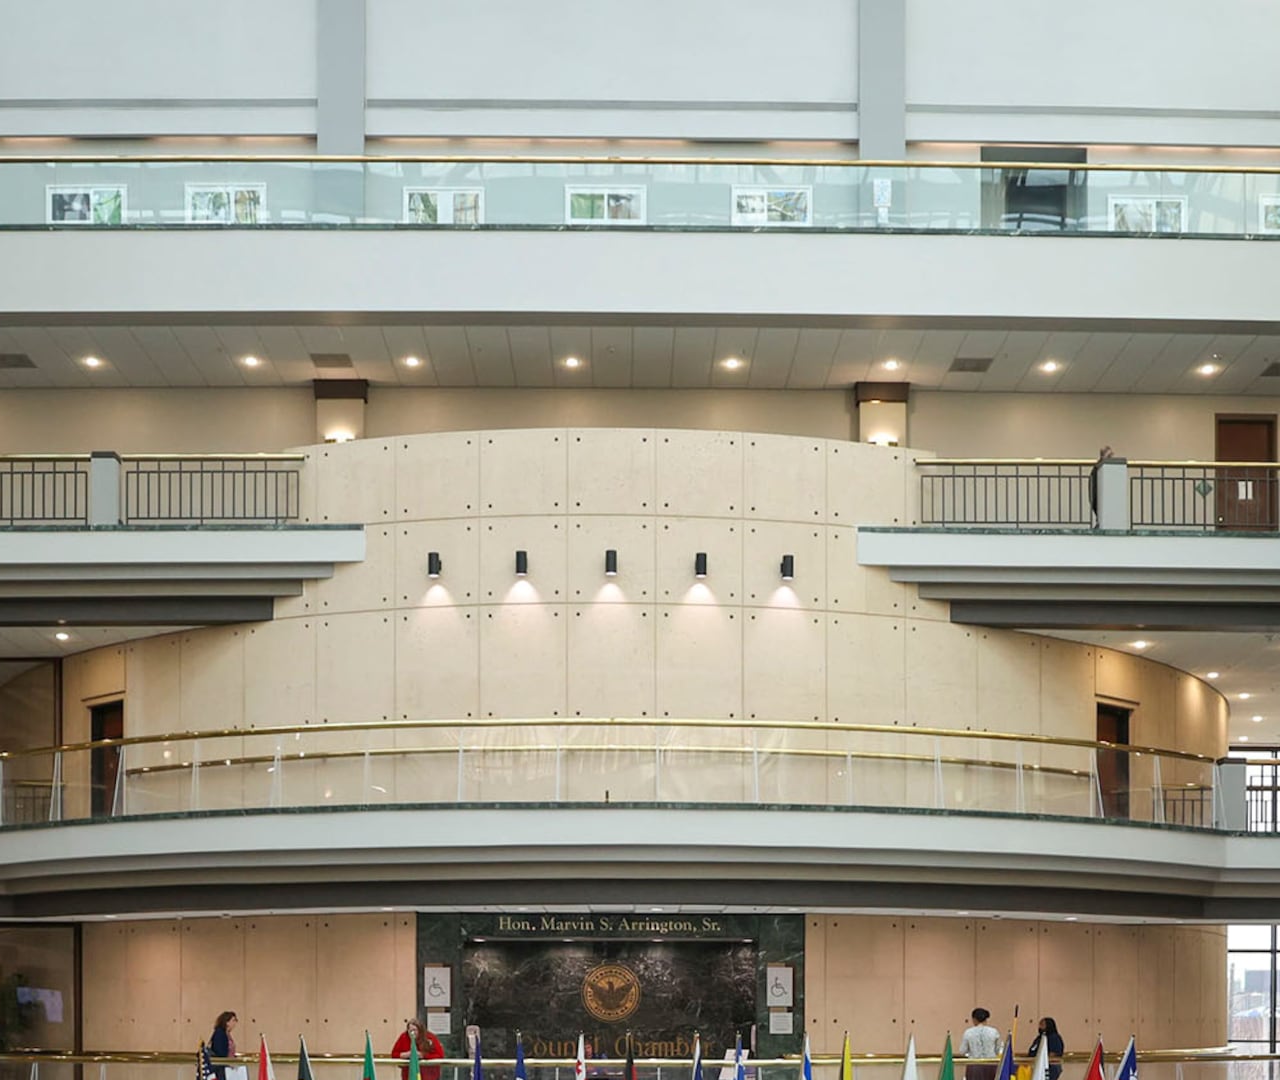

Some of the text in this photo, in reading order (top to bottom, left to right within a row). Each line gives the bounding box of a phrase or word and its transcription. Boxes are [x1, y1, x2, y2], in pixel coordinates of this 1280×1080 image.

[498, 916, 721, 934] Hon. Marvin S. Arrington, Sr.
